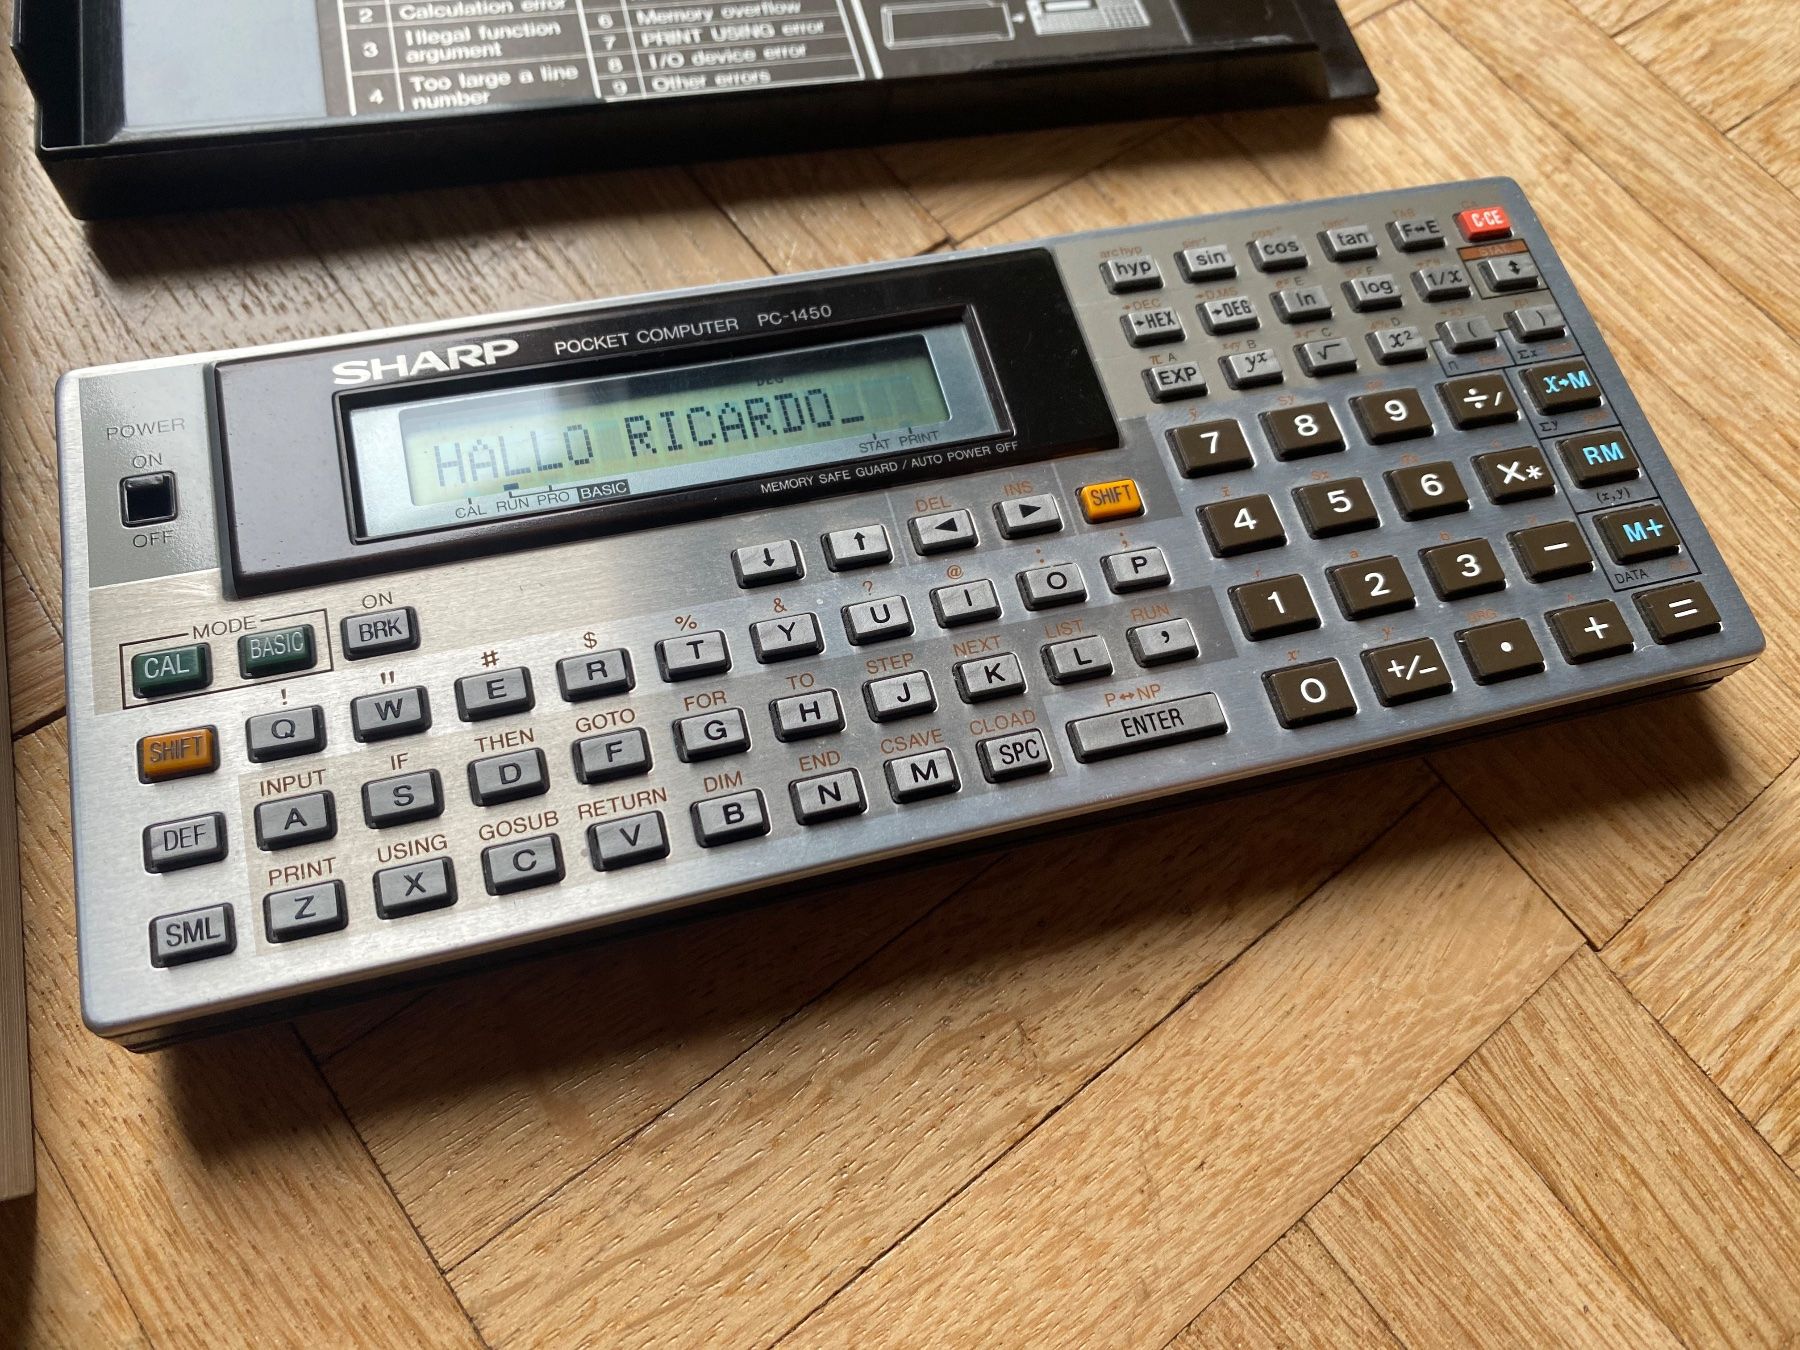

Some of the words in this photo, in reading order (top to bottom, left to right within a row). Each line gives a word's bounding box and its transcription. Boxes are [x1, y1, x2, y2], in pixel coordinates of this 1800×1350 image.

[359, 8, 373, 23] 2
[400, 0, 514, 20] Calculation
[636, 6, 713, 26] Memory
[721, 0, 801, 19] overflow
[404, 26, 471, 46] Illegal
[478, 20, 561, 41] function
[602, 35, 617, 50] 7
[641, 27, 703, 48] PRINT
[781, 19, 825, 36] error
[362, 41, 379, 58] 3
[406, 41, 503, 64] argument
[648, 51, 685, 70] I/O
[691, 46, 757, 67] device
[763, 43, 807, 61] error
[409, 75, 452, 93] Too
[458, 70, 511, 89] large
[519, 69, 534, 84] a
[540, 63, 579, 82] line
[651, 73, 707, 93] Other
[714, 69, 771, 86] errors
[369, 88, 384, 105] 4
[411, 90, 491, 110] number
[1264, 240, 1299, 256] cos
[1337, 232, 1369, 246] tan
[1115, 259, 1151, 277] hyp
[1196, 250, 1226, 266] sin
[1362, 279, 1394, 295] log
[554, 332, 630, 356] POCKET
[636, 317, 739, 345] COMPUTER
[757, 305, 833, 328] PC-1450
[333, 338, 519, 385] SHARP
[1158, 366, 1197, 385] EXP
[1384, 399, 1408, 421] 9
[106, 417, 185, 440] POWER
[1293, 414, 1318, 436] 8
[859, 438, 890, 454] STAT
[899, 430, 939, 447] PRINT
[1200, 431, 1219, 454] 7
[1583, 441, 1625, 466] RM
[132, 453, 163, 469] ON
[433, 424, 594, 487] HALLO
[760, 475, 814, 495] MEMORY
[819, 470, 851, 484] SAFE
[856, 461, 898, 478] GUARD
[911, 454, 943, 469] AUTO
[947, 446, 992, 462] POWER
[996, 440, 1019, 453] OFF
[1003, 480, 1034, 496] INS
[1090, 484, 1133, 507] SHIFT
[1420, 473, 1443, 496] 6
[455, 504, 487, 519] CAL
[496, 497, 530, 513] RUN
[537, 491, 570, 506] PRO
[580, 482, 627, 500] BASIC
[914, 495, 952, 513] DEL
[1327, 490, 1352, 513] 5
[1233, 507, 1257, 530] 4
[133, 530, 174, 548] OFF
[1622, 518, 1664, 543] M+
[946, 564, 964, 580] @
[1130, 556, 1148, 574] P
[1456, 553, 1481, 577] 3
[862, 580, 873, 596] ?
[1364, 572, 1391, 597] 2
[1615, 569, 1649, 585] DATA
[362, 591, 393, 609] ON
[773, 597, 787, 613] &
[1267, 591, 1285, 614] 1
[675, 614, 697, 631] %
[870, 604, 891, 624] U
[1130, 603, 1169, 622] RUN
[192, 615, 257, 640] MODE
[359, 617, 402, 642] BRK
[777, 621, 795, 642] Y
[1044, 619, 1084, 639] LIST
[250, 631, 304, 660] BASIC
[583, 632, 598, 649] $
[685, 639, 704, 659] T
[953, 635, 1001, 657] NEXT
[144, 655, 189, 679] CAL
[480, 650, 500, 667] #
[865, 652, 915, 675] STEP
[1073, 647, 1092, 666] L
[586, 660, 608, 680] R
[786, 672, 815, 690] TO
[984, 663, 1006, 683] K
[486, 678, 507, 700] E
[683, 690, 727, 711] FOR
[897, 682, 911, 703] J
[374, 698, 403, 721] W
[575, 708, 635, 732] GOTO
[799, 700, 821, 723] H
[271, 718, 296, 739] Q
[704, 719, 728, 741] G
[969, 710, 1037, 736] CLOAD
[1121, 708, 1184, 738] ENTER
[150, 736, 203, 763] SHIFT
[474, 727, 535, 753] THEN
[605, 740, 623, 763] F
[880, 728, 944, 755] CSAVE
[1000, 738, 1040, 765] SPC
[391, 753, 409, 771] IF
[799, 750, 841, 772] END
[911, 759, 939, 783] M
[260, 769, 327, 796] INPUT
[499, 762, 521, 784] D
[703, 770, 744, 793] DIM
[393, 785, 415, 806] S
[577, 786, 668, 820] RETURN
[817, 781, 842, 805] N
[284, 807, 308, 830] A
[722, 802, 745, 825] B
[163, 823, 207, 851] DEF
[478, 810, 559, 841] GOSUB
[620, 823, 641, 847] V
[377, 834, 448, 863] USING
[268, 857, 337, 885] PRINT
[512, 849, 537, 872] C
[403, 871, 427, 897] X
[294, 895, 317, 920] Z
[166, 919, 221, 947] SML
